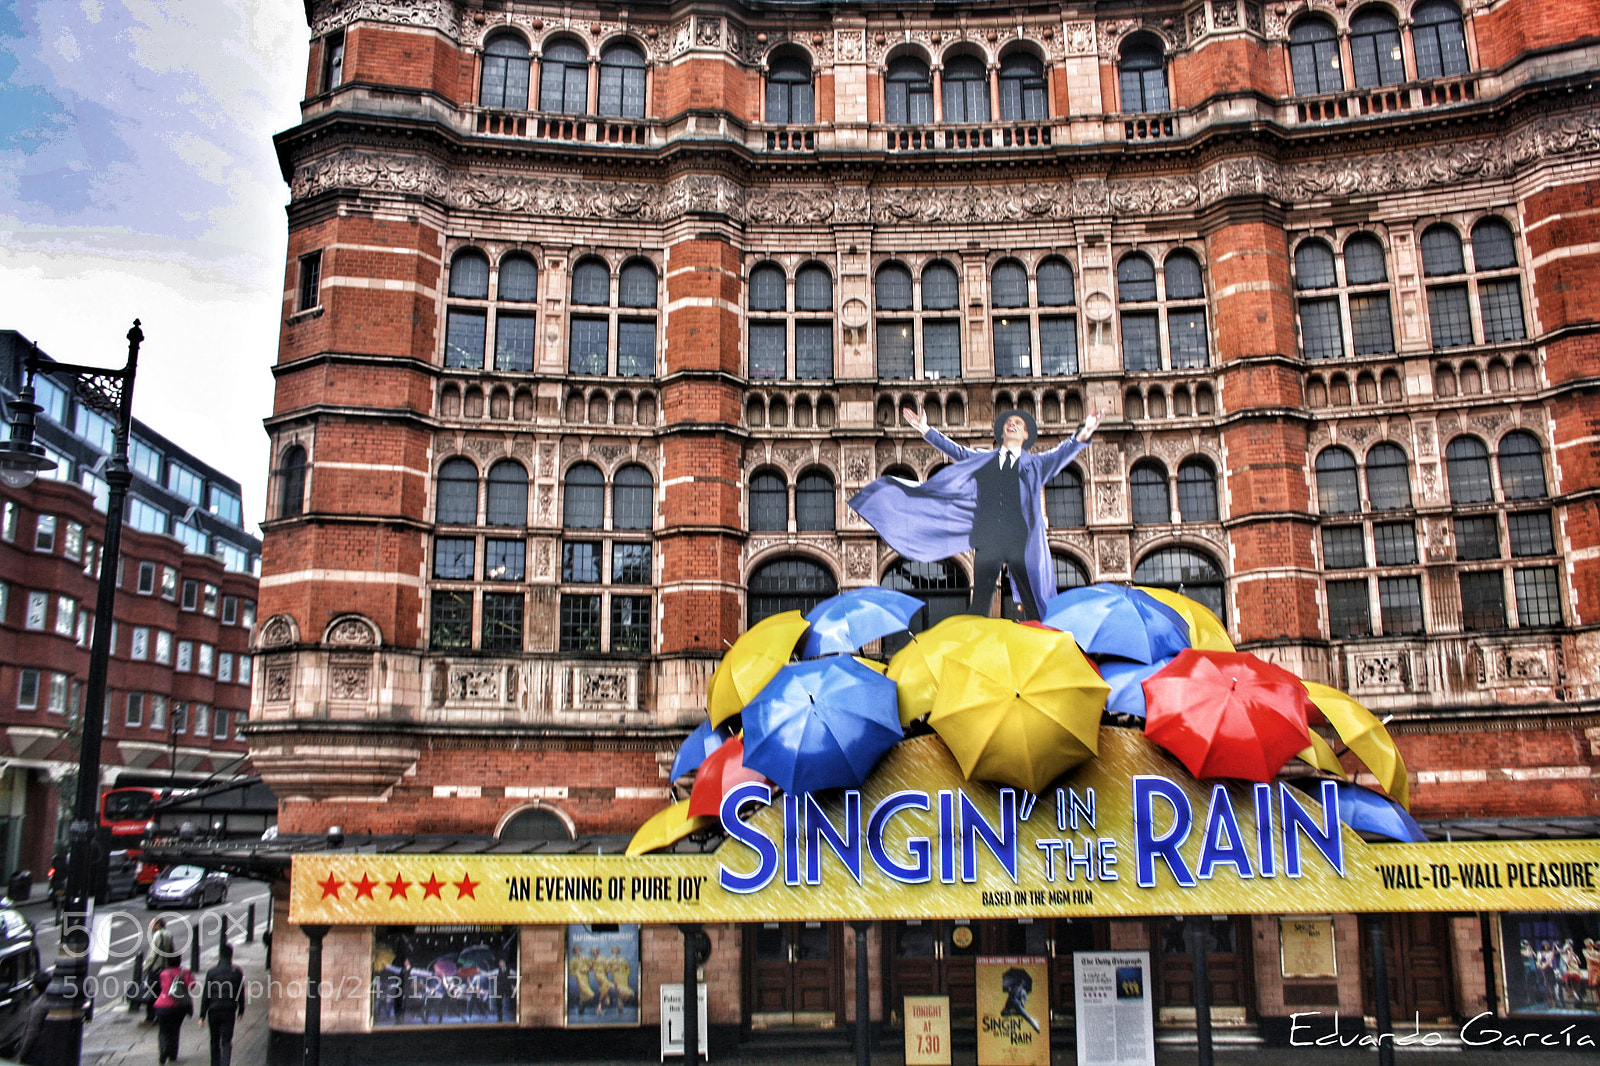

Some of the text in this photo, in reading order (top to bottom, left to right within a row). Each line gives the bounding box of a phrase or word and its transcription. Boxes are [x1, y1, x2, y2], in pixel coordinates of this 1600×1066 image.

[719, 774, 1345, 894] SINGIN' IN THE RAIN
[536, 876, 602, 902] EVENING
[607, 876, 625, 901] OF
[631, 876, 672, 902] PURE
[982, 889, 1093, 906] BASED ON THE MGM FILM
[1081, 956, 1142, 966] The Daily Telegraph
[912, 1005, 942, 1018] TONIGHT
[923, 1020, 931, 1032] AT
[917, 1035, 940, 1054] 7.30
[1010, 1032, 1032, 1045] RAIN
